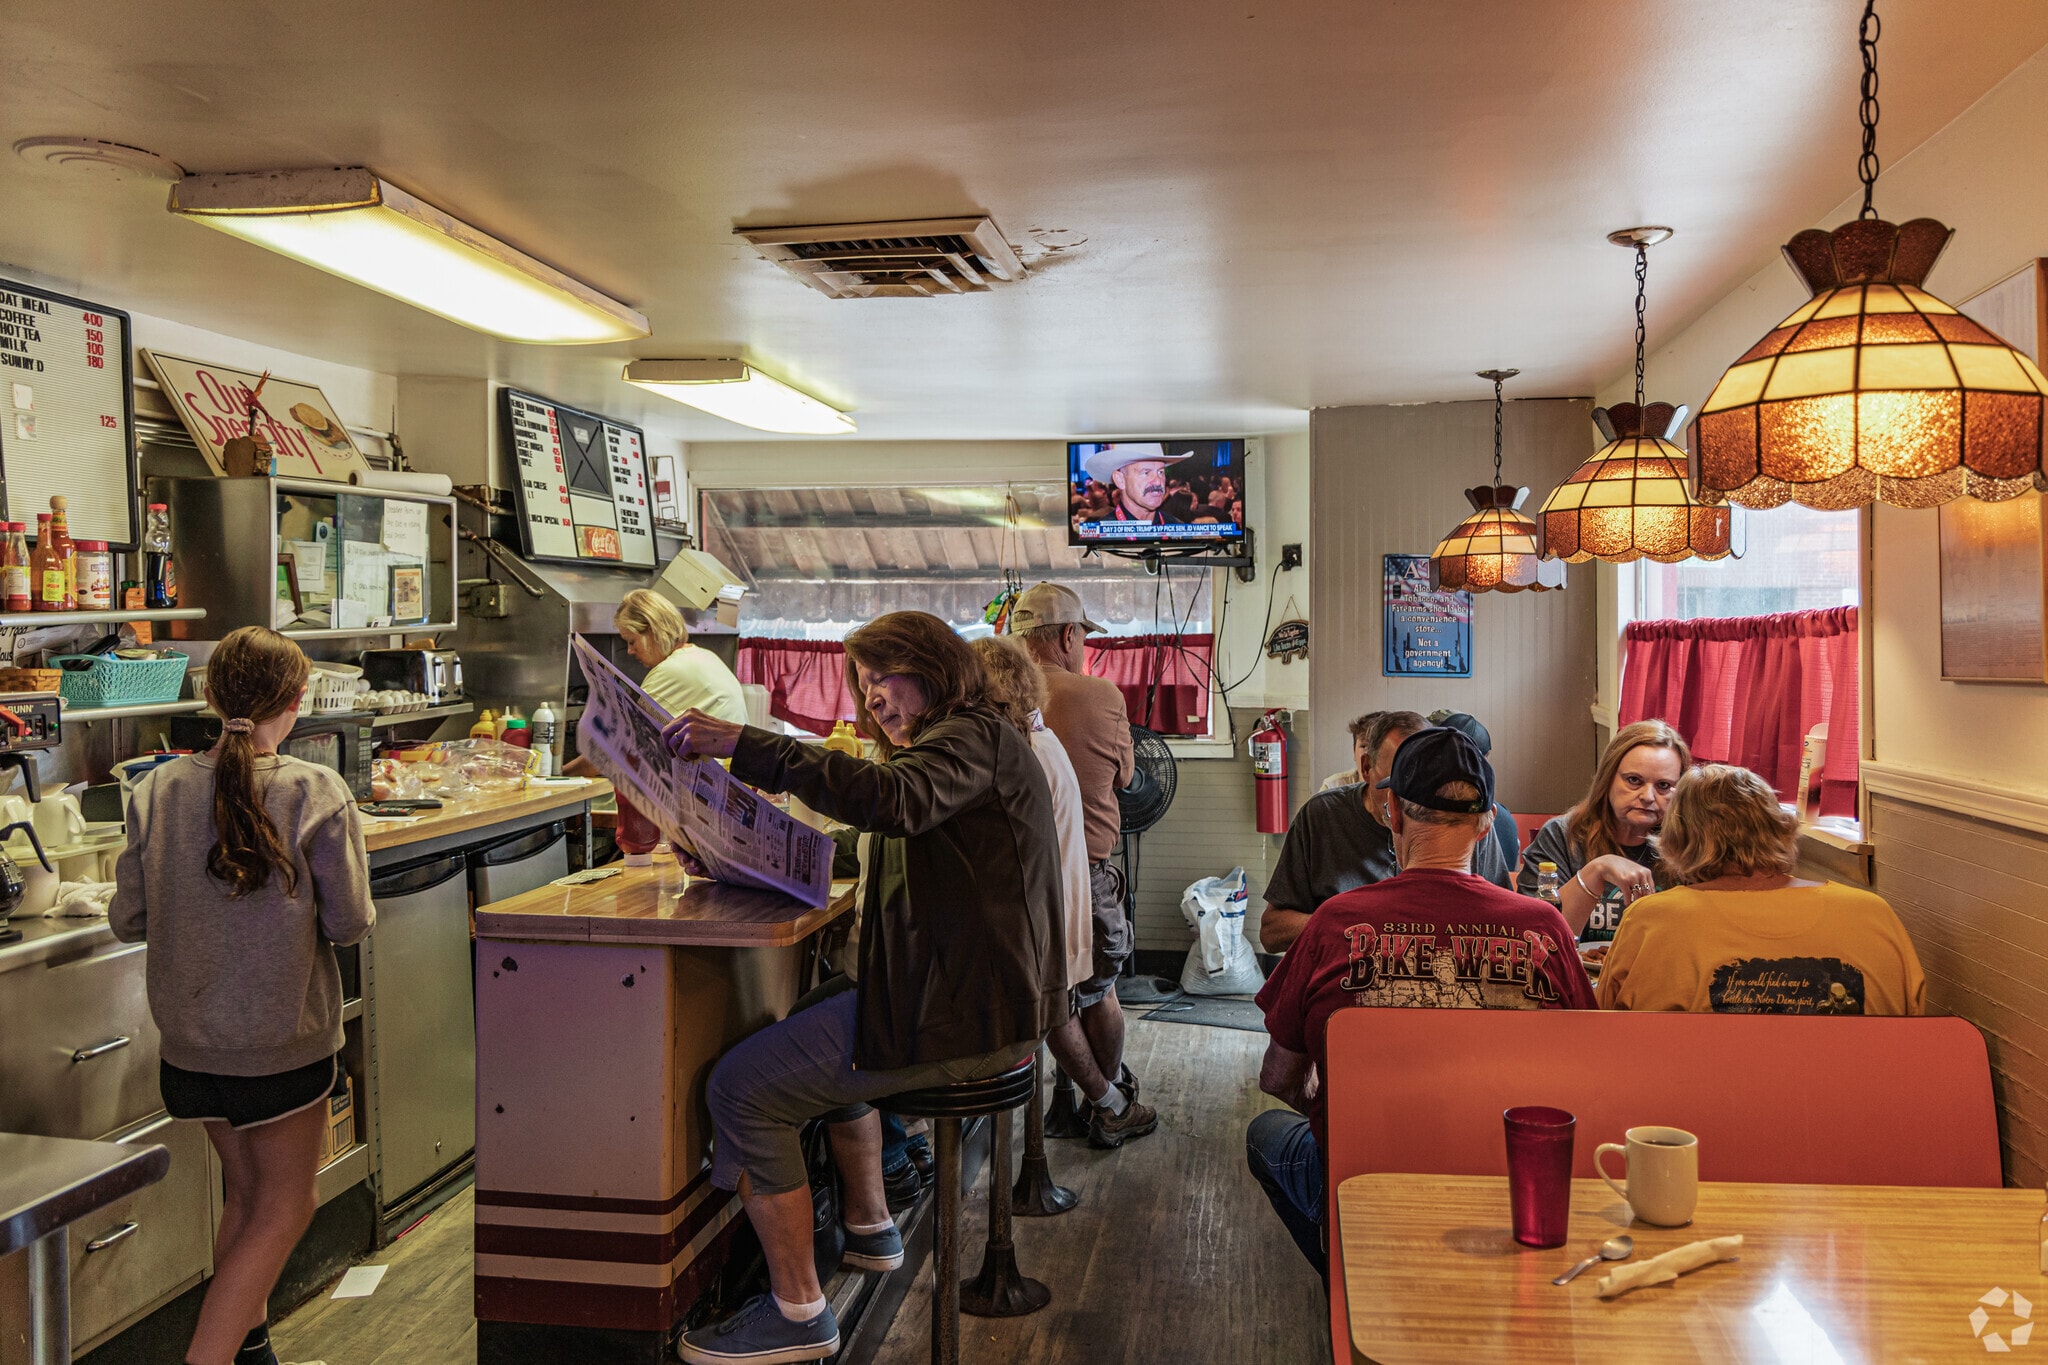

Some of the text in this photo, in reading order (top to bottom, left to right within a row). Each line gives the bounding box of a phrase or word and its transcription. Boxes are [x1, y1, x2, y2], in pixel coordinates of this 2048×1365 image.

[21, 298, 51, 315] MEAL
[0, 308, 35, 327] COFFEE
[83, 312, 103, 327] 400
[0, 322, 41, 342] HOT TEA
[85, 329, 103, 343] 150
[0, 337, 28, 353] MILK
[86, 342, 104, 356] 100
[37, 360, 44, 372] D
[86, 355, 104, 369] 180
[99, 415, 117, 428] 125
[1136, 525, 1157, 533] TRUMP'S
[1404, 594, 1454, 604] Tobacco, and
[1391, 604, 1466, 613] Firearms should be
[1407, 614, 1457, 623] convenience
[1415, 625, 1442, 633] store...
[1418, 638, 1432, 647] Not
[1405, 649, 1451, 659] government
[1413, 658, 1444, 668] agency!
[1383, 922, 1521, 938] 83RD ANNUAL
[1340, 922, 1560, 1001] BIKE WEEK
[1735, 980, 1746, 993] you
[1748, 972, 1768, 987] could
[1788, 980, 1800, 995] way
[1801, 979, 1809, 988] to
[1742, 988, 1755, 1004] the
[1756, 993, 1774, 1005] Notre
[1776, 993, 1795, 1005] Dame
